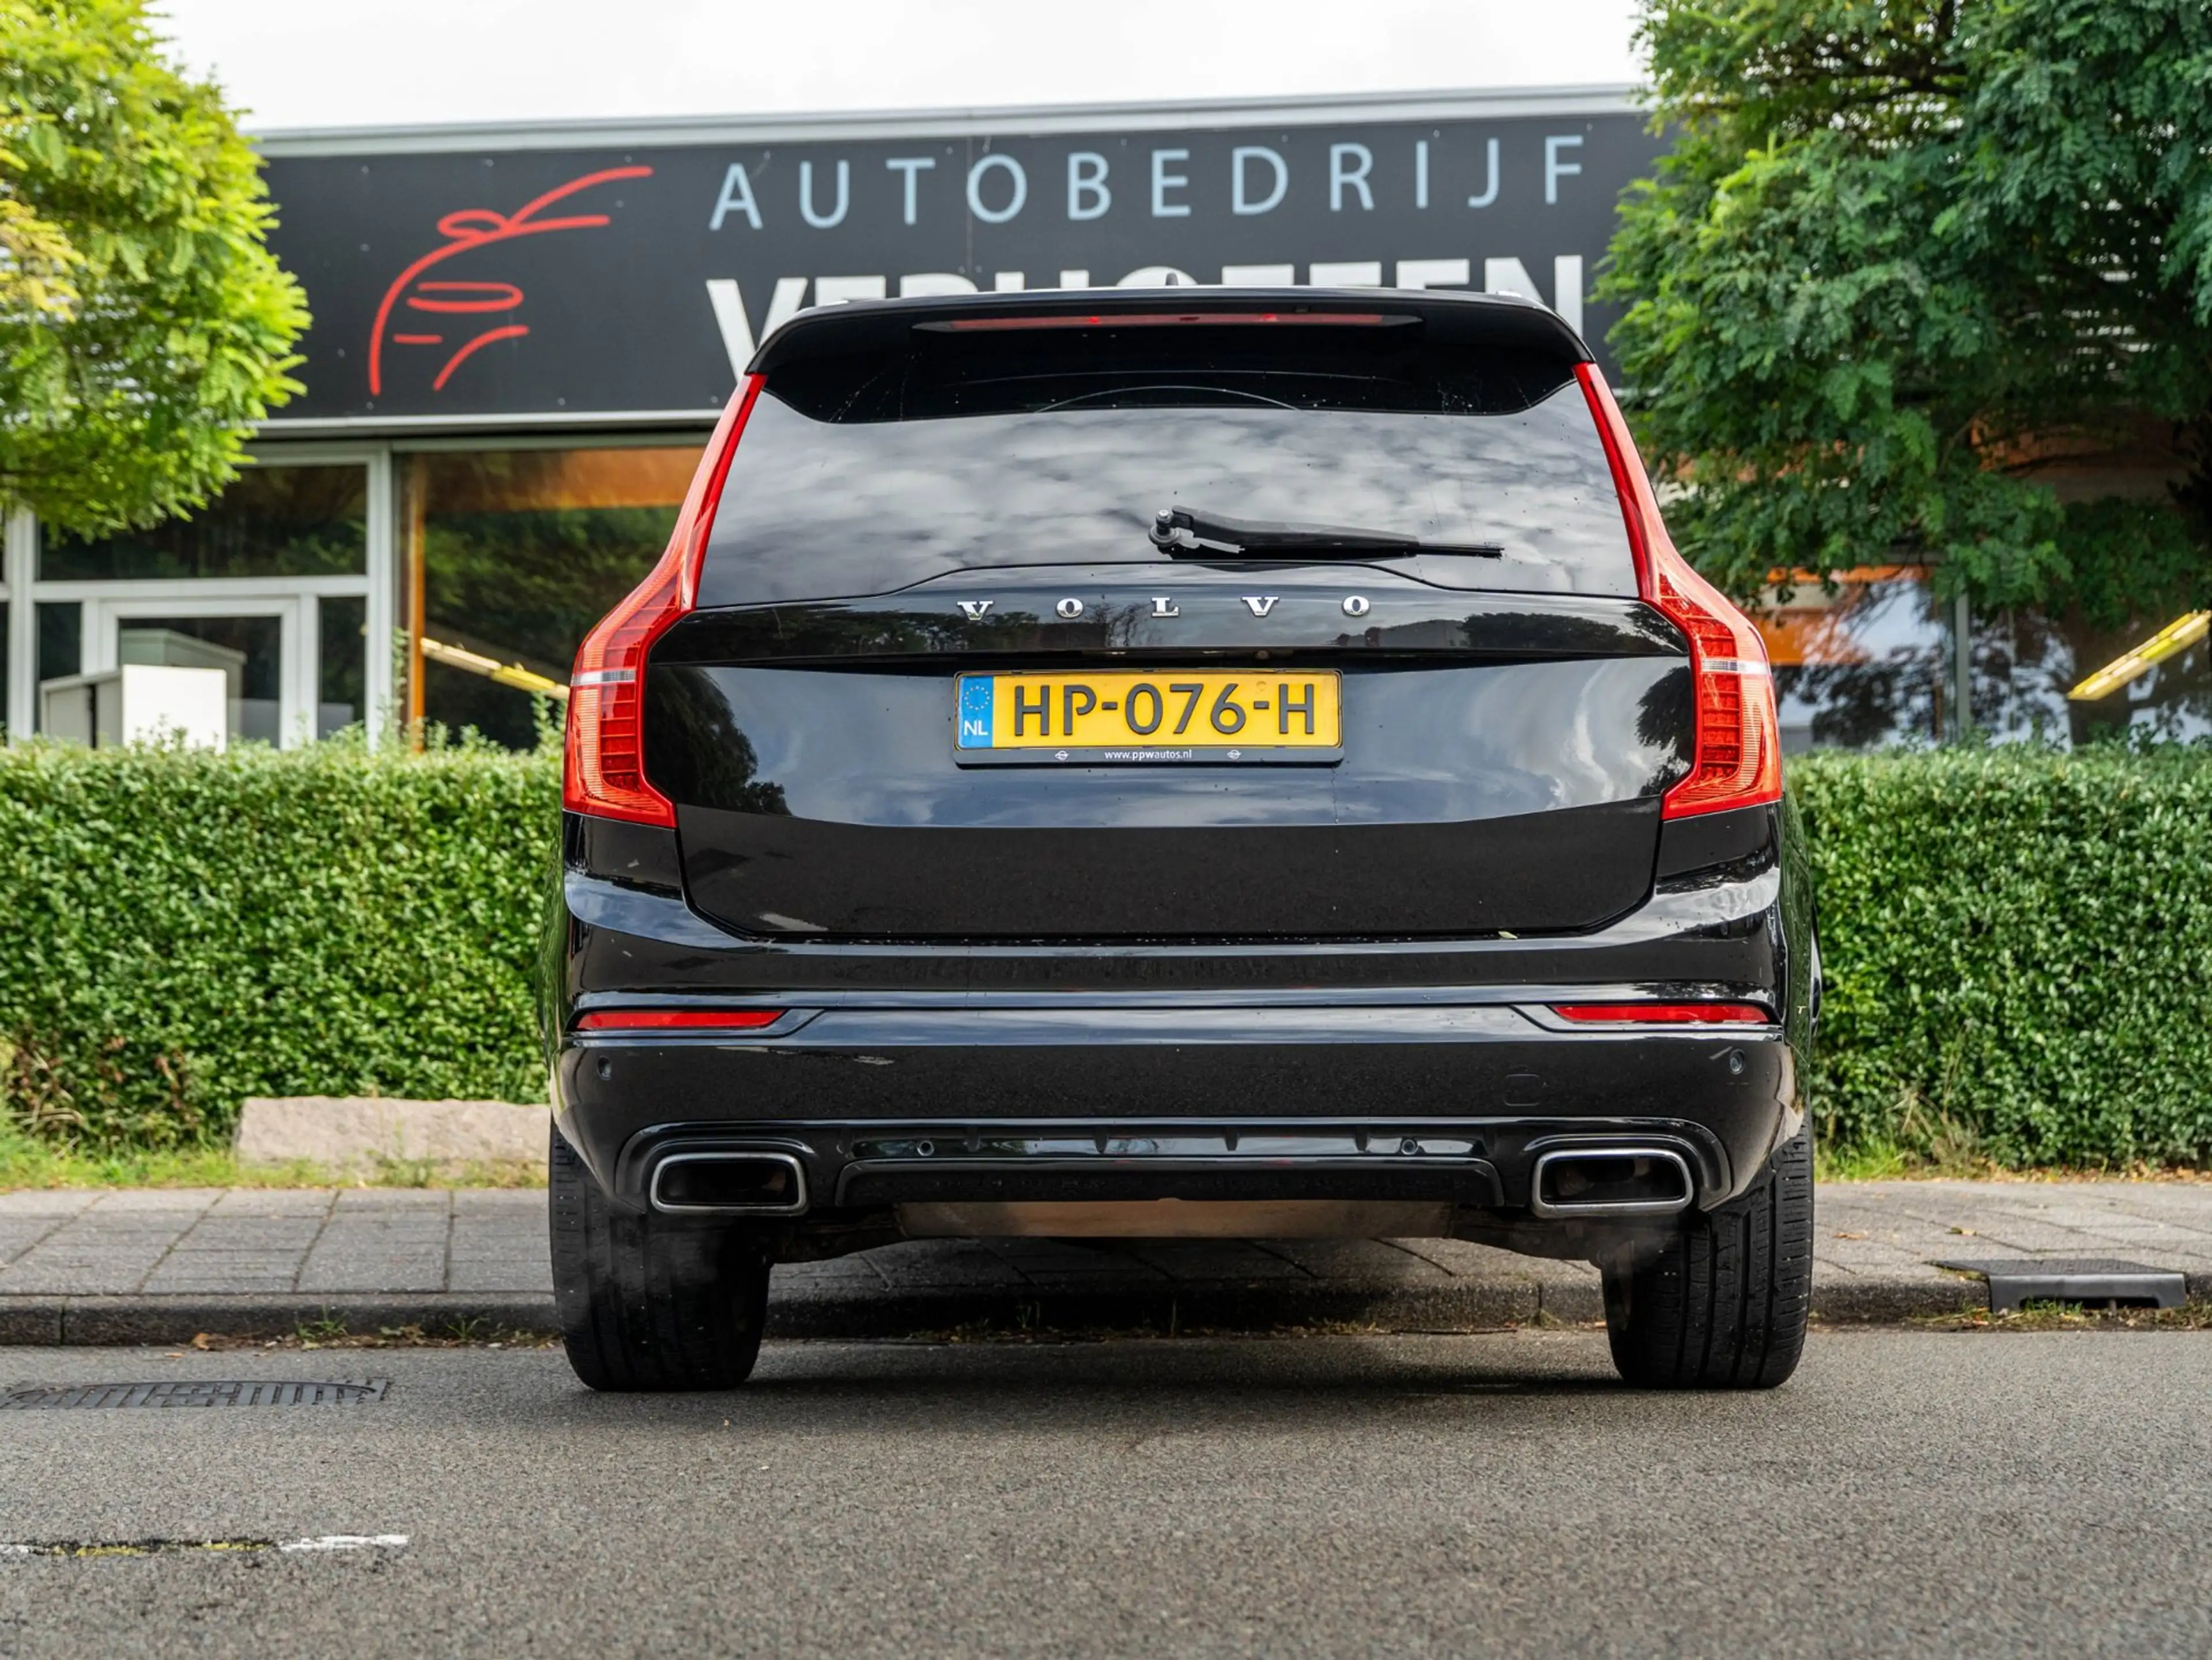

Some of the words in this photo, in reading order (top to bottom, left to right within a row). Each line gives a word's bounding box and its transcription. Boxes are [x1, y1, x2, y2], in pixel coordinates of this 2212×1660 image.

[709, 135, 1584, 230] AUTOBEDRIJF
[957, 595, 1371, 620] VOLVO
[1014, 683, 1315, 737] HP-076-H
[964, 720, 988, 737] NL
[1104, 749, 1192, 761] www.ppwautos.nl
